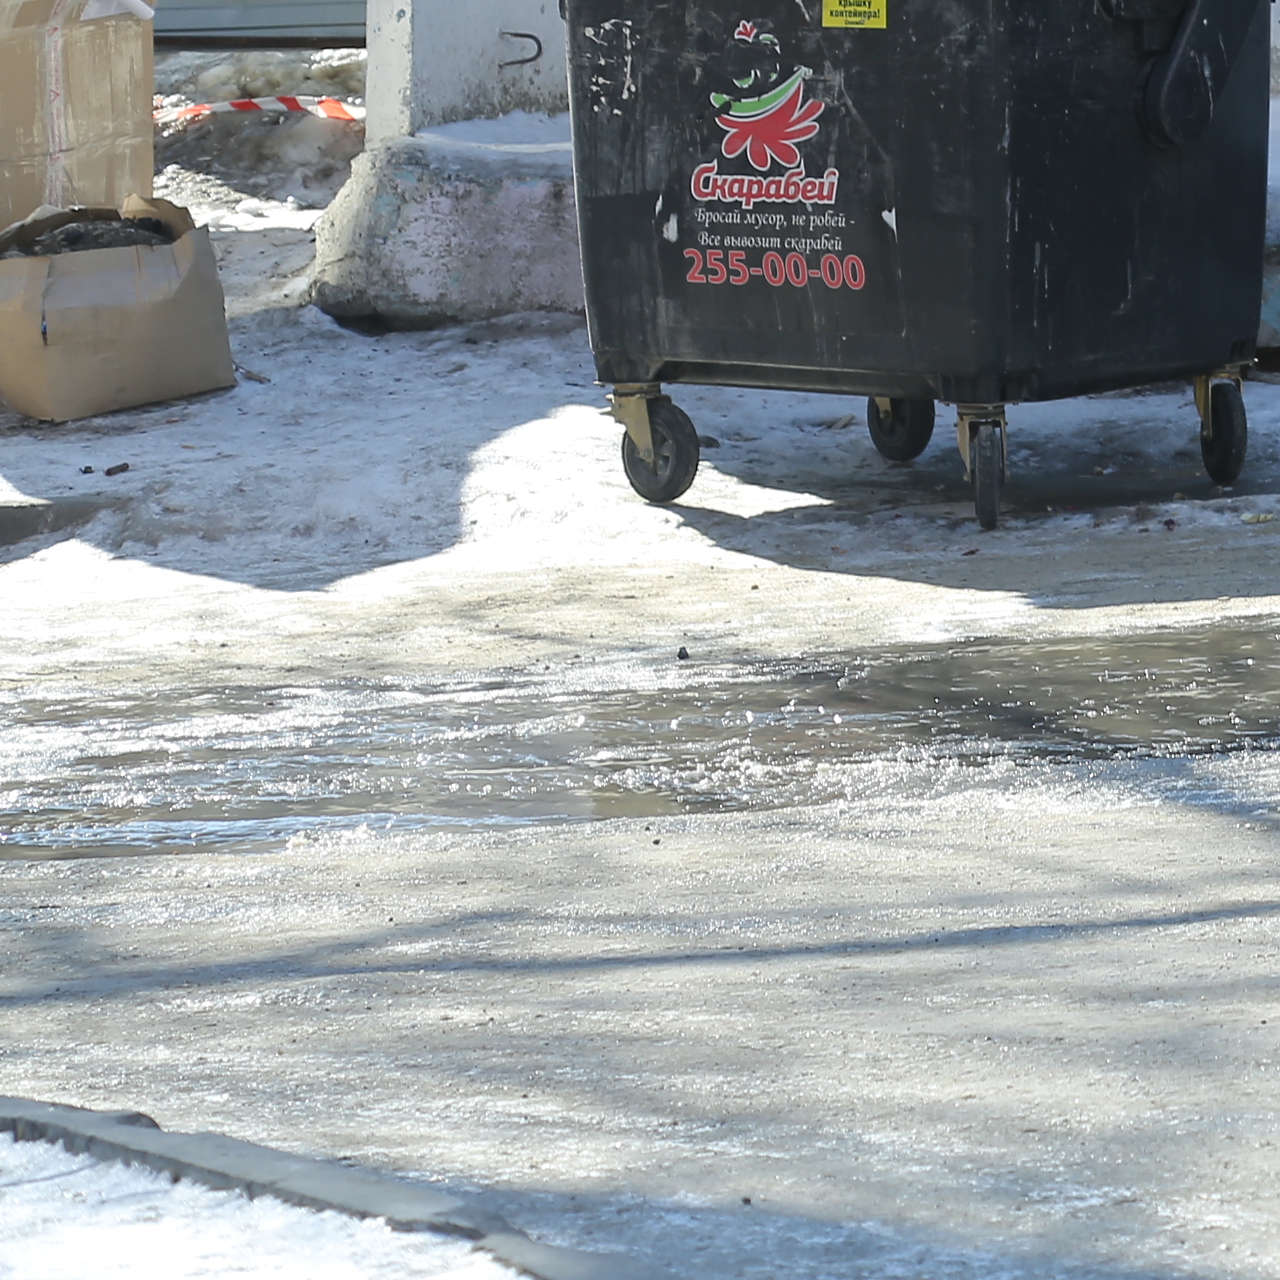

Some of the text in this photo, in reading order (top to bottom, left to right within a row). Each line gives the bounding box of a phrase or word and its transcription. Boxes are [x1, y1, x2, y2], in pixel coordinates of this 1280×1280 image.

[830, 8, 880, 20] контейнера!
[838, 0, 872, 9] крышку
[691, 157, 839, 210] Скарабей
[694, 207, 741, 227] Бросай
[743, 212, 788, 230] мусор,
[791, 213, 807, 225] не
[809, 209, 846, 231] робей
[698, 230, 843, 254] Все вывозит скарабей
[683, 247, 866, 291] 255-00-00
